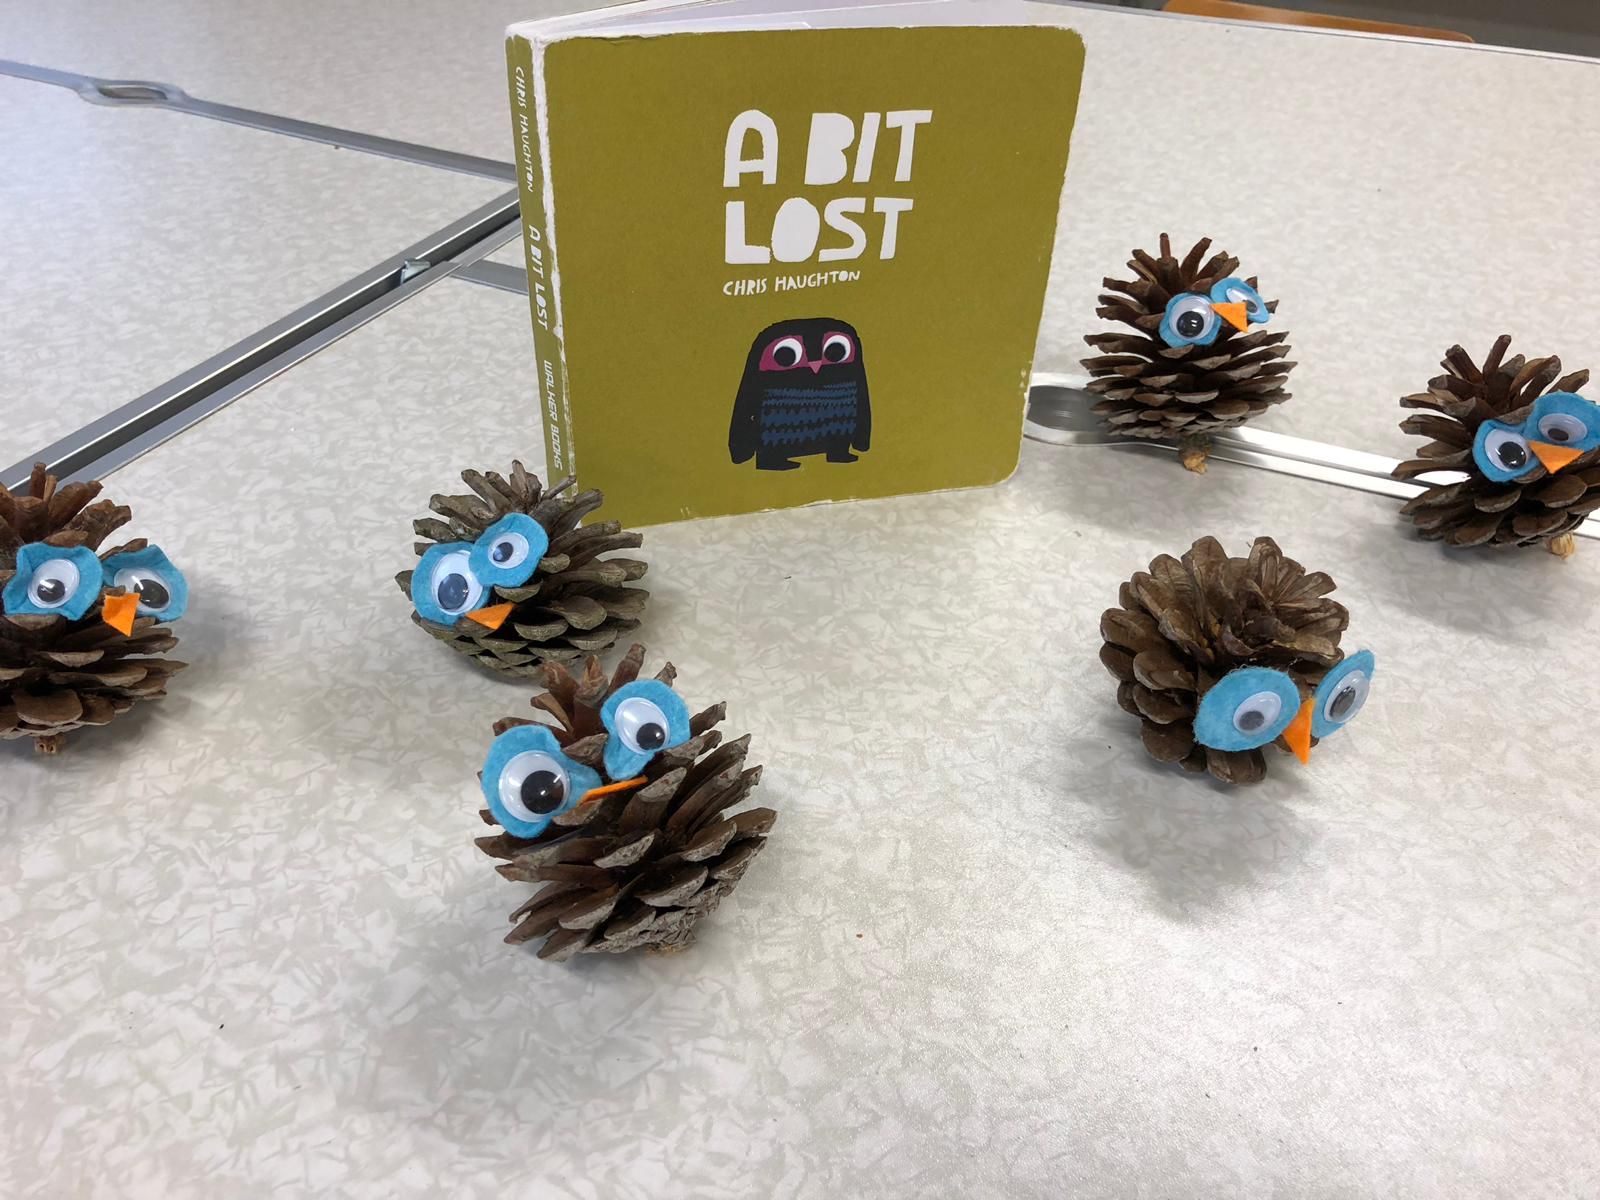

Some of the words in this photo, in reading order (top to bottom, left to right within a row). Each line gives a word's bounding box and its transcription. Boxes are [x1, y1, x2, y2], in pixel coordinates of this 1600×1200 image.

[515, 65, 527, 109] CHRIS
[519, 113, 534, 193] HAUGHTON
[722, 108, 779, 188] A
[804, 110, 933, 186] BIT
[528, 224, 541, 241] A
[724, 196, 914, 265] LOST
[530, 244, 544, 279] BIT
[722, 278, 768, 297] CHRIS
[774, 270, 861, 293] HAUGHTON
[535, 282, 548, 331] LOST
[543, 359, 558, 422] WALKER
[550, 423, 563, 471] BOOKS
